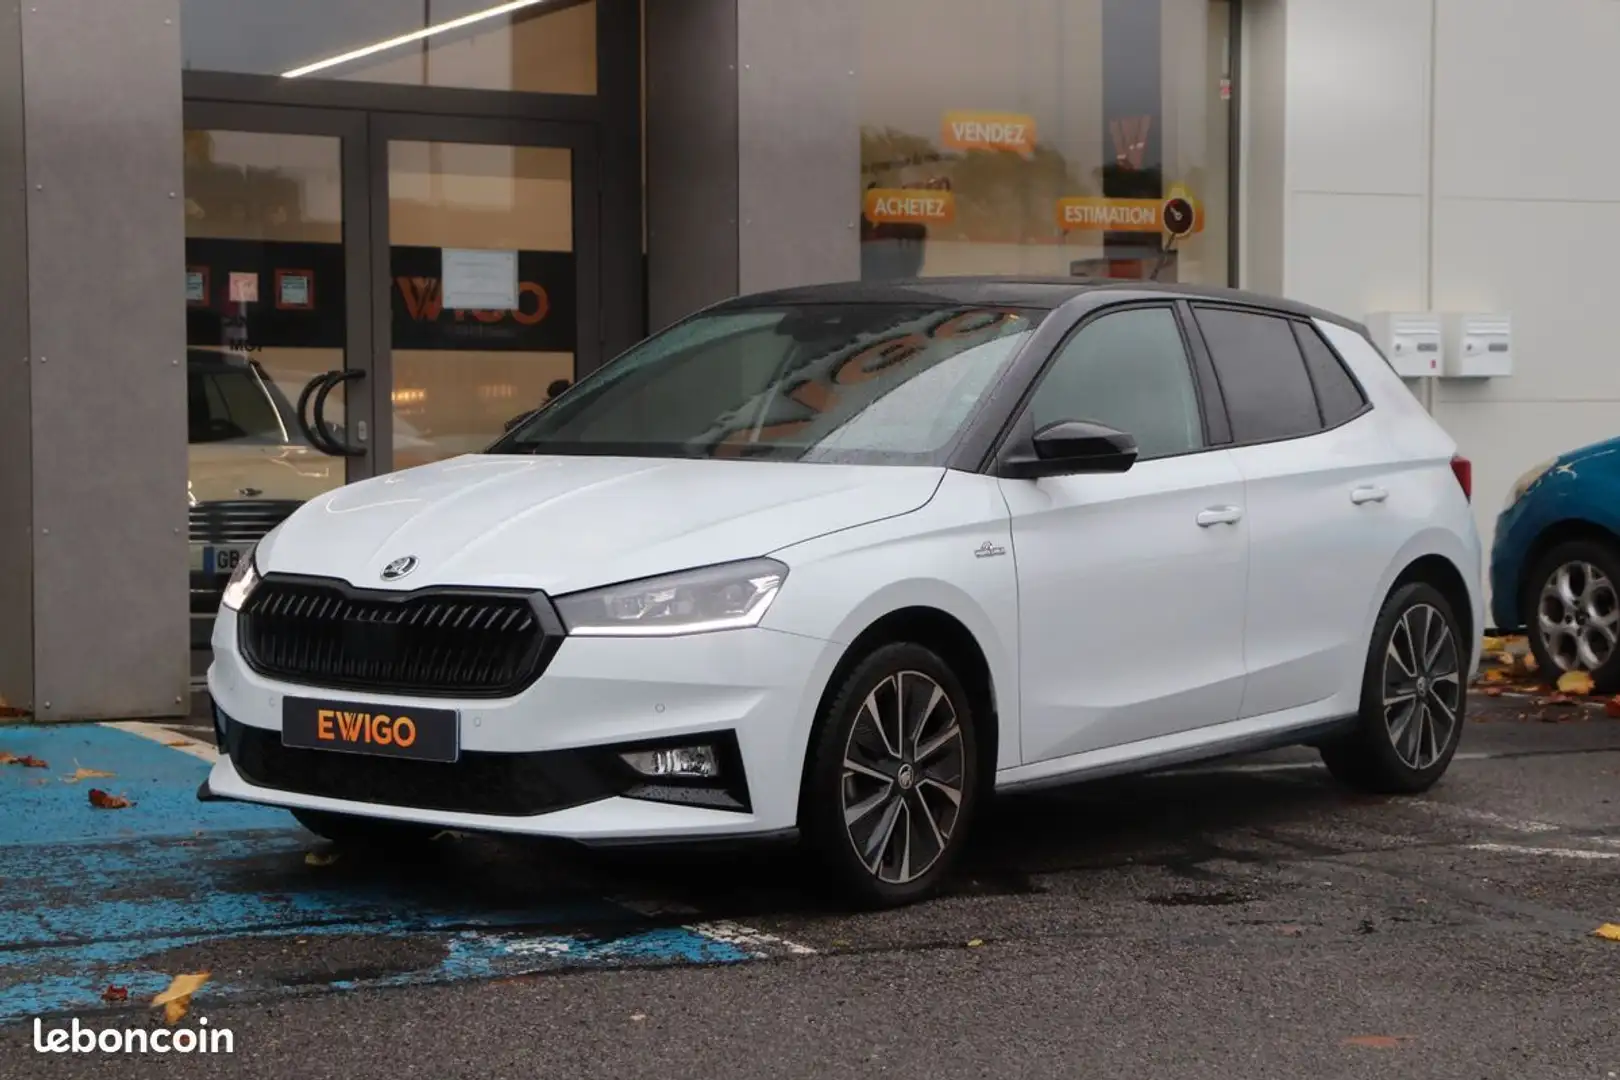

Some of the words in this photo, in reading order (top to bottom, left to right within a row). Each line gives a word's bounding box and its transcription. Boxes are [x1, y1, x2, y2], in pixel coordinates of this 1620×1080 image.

[951, 120, 1027, 146] VENDEZ
[873, 196, 946, 217] ACHETEZ
[1064, 205, 1156, 225] ESTIMATION
[317, 709, 417, 748] EWIGO
